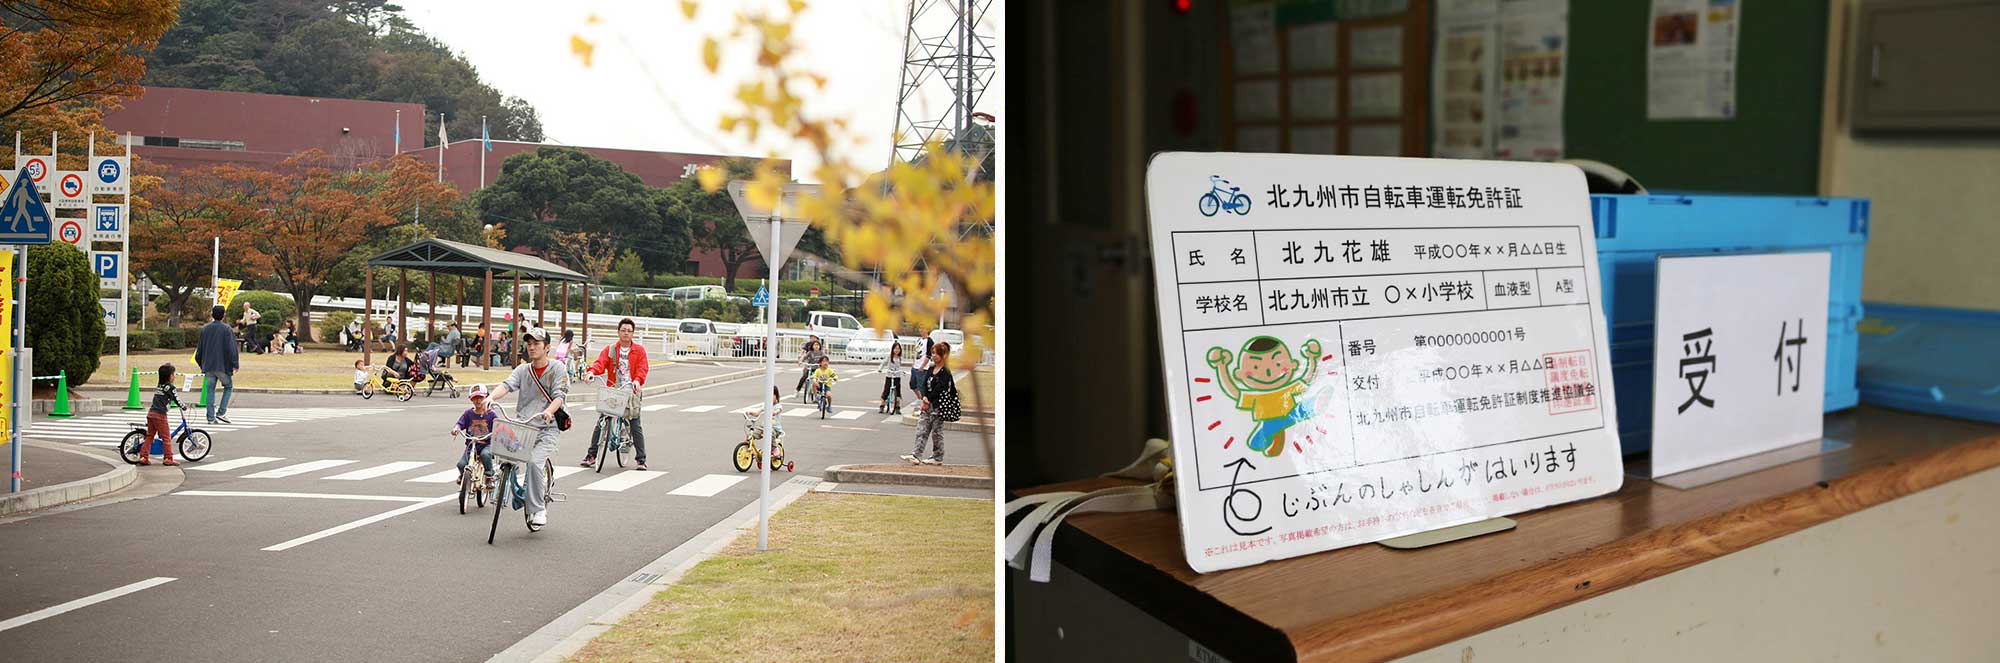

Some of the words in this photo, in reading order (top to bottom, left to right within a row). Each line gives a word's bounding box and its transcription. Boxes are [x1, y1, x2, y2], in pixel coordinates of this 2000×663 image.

[1266, 183, 1524, 210] 北九州市自転車運転免許証
[100, 255, 114, 276] P
[1282, 239, 1393, 265] 北九花雄
[1195, 294, 1249, 314] 学校名
[1268, 286, 1370, 312] 北九州市立
[1494, 281, 1532, 297] 血液型
[1555, 279, 1575, 294] A型
[1347, 338, 1377, 357] 番号
[1413, 326, 1526, 348] 第0000000001号
[1677, 318, 1808, 415] 受付
[1353, 373, 1381, 391] 交付
[1282, 442, 1578, 518] じぶんのしゃしんがはいります
